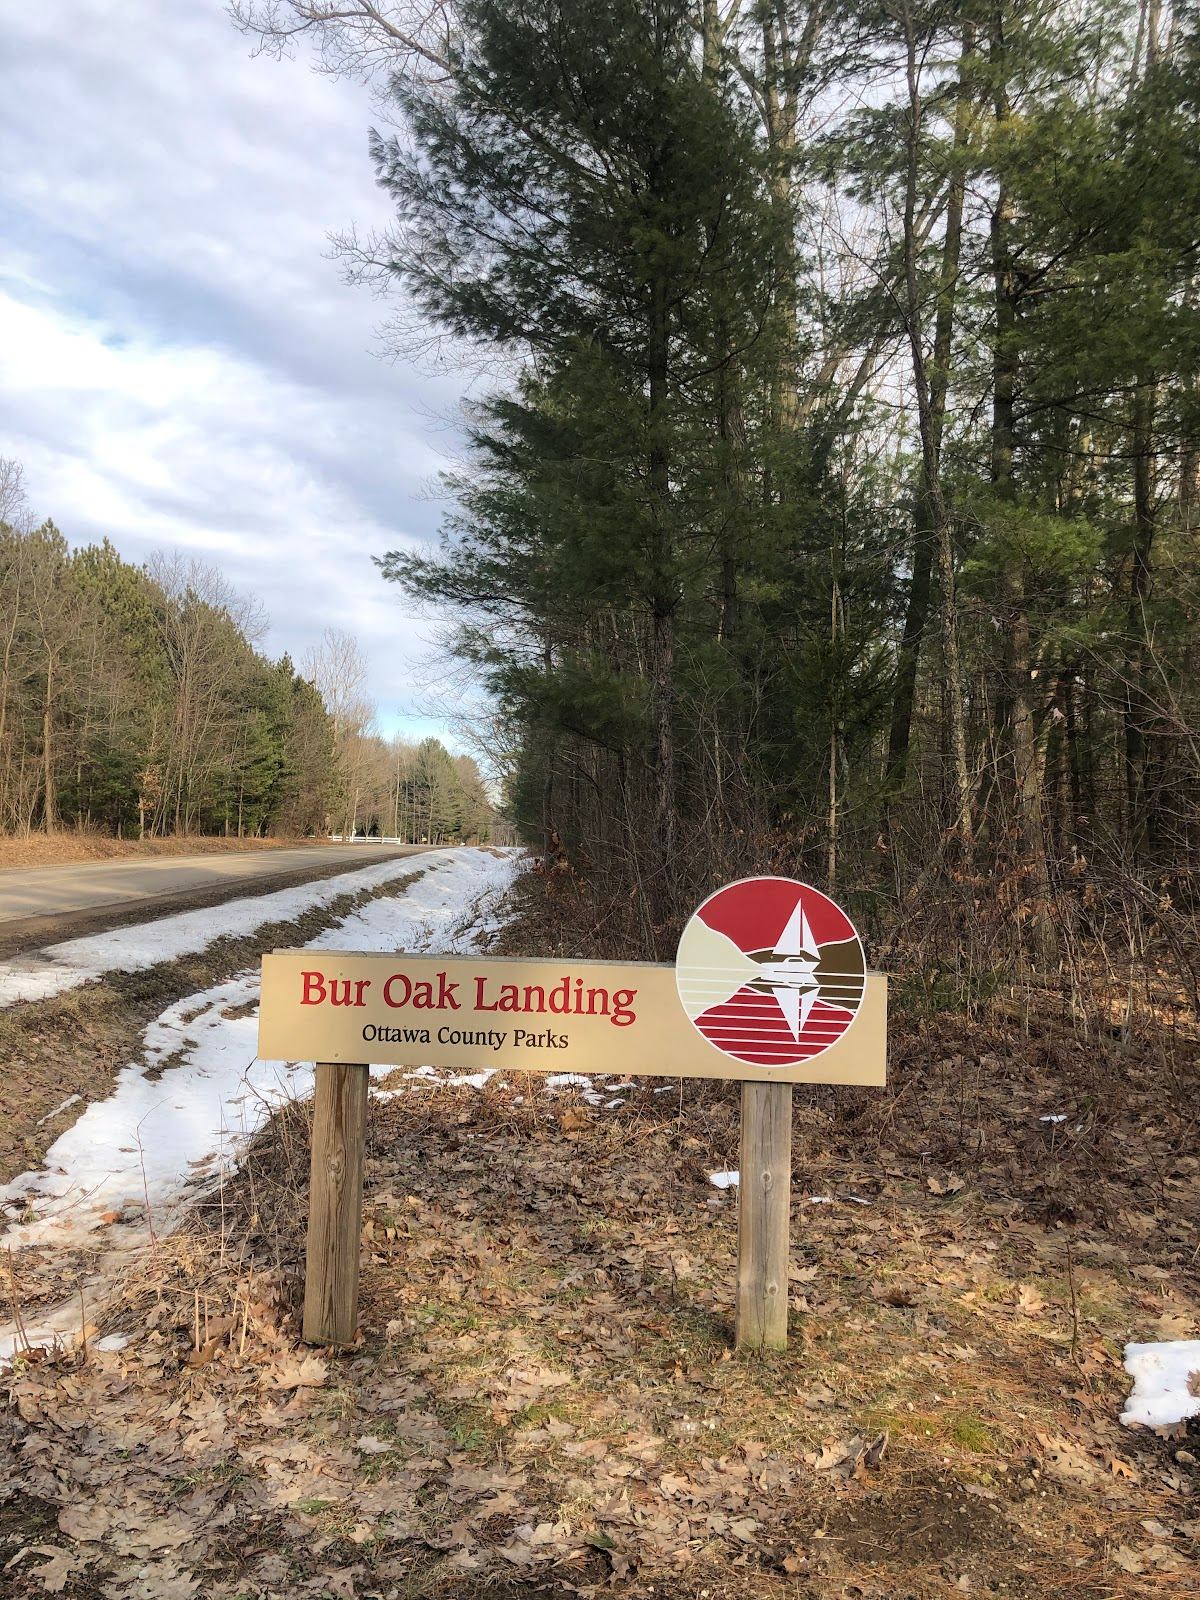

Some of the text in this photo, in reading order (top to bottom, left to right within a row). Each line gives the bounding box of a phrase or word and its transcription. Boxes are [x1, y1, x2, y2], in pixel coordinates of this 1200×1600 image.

[300, 970, 638, 1027] Bur Oak Landing
[362, 1024, 569, 1051] Ottawa County Parks
